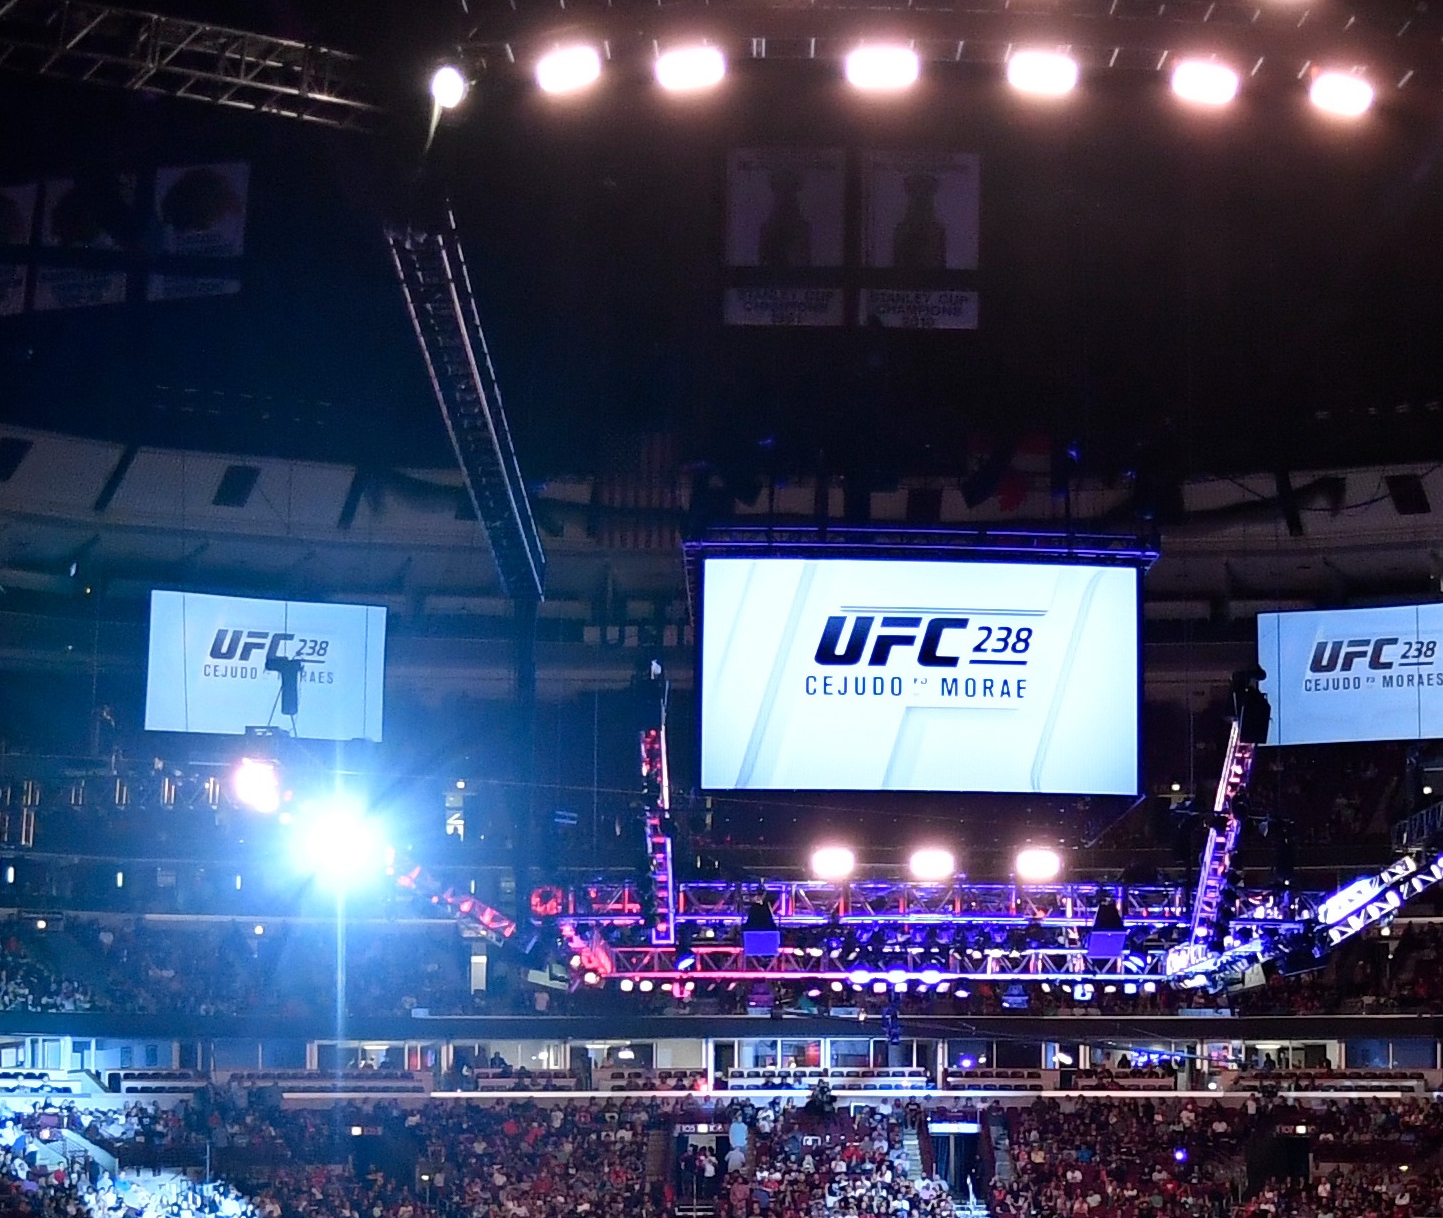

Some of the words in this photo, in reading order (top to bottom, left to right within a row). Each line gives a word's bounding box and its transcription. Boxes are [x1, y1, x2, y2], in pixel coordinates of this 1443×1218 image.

[209, 628, 295, 662] UFC
[295, 638, 329, 657] 238
[814, 615, 970, 667] UFC
[972, 625, 1033, 654] 238
[1309, 637, 1399, 673] UFC
[1400, 640, 1437, 659] 238
[203, 664, 258, 680] CEJUDO
[805, 675, 902, 696] CEJUDO
[1304, 676, 1361, 692] CEJUDO
[1382, 672, 1443, 688] MORAES
